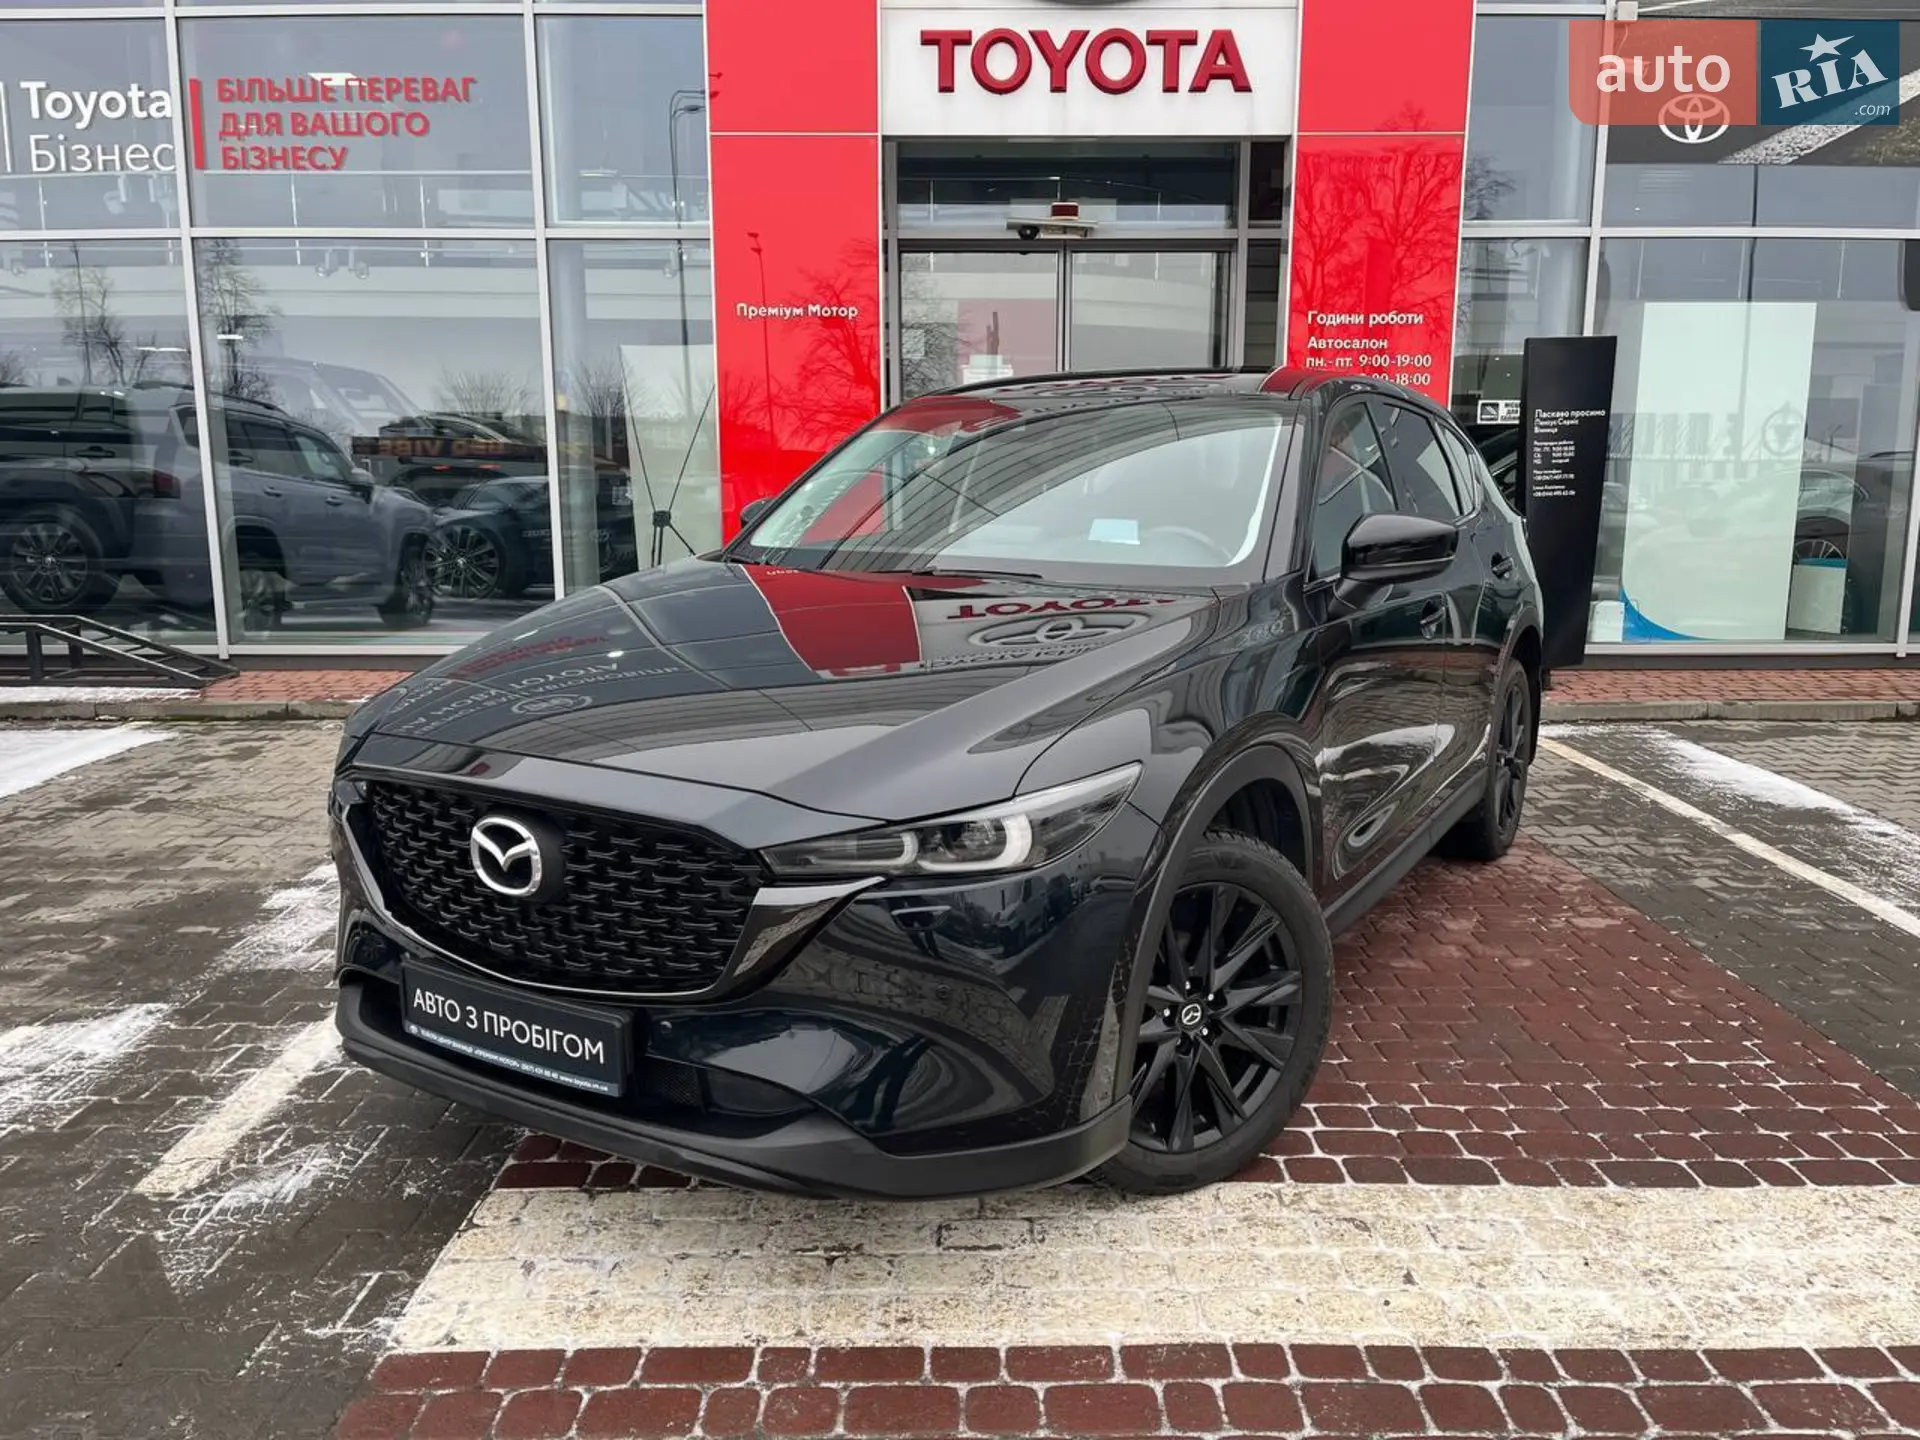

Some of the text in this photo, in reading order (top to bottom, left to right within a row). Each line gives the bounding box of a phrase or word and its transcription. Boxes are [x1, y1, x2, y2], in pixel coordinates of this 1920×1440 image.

[920, 27, 1253, 95] TOYOTA
[216, 77, 478, 103] БІЛЬШЕ ПЕРЕВАГ
[19, 80, 172, 130] Toyota
[218, 111, 431, 141] ДЛЯ ВАШОГО
[29, 133, 176, 173] Бізнес
[221, 145, 349, 170] БІЗНЕСУ
[736, 302, 859, 320] Преміум Мотор
[1307, 310, 1424, 328] Години роботи
[1307, 335, 1389, 350] Автосалон
[1358, 353, 1432, 368] 9:00-19:00
[413, 988, 460, 1022] АВТО
[465, 1006, 478, 1029] З
[483, 1010, 605, 1064] ПРОБІГОМ
